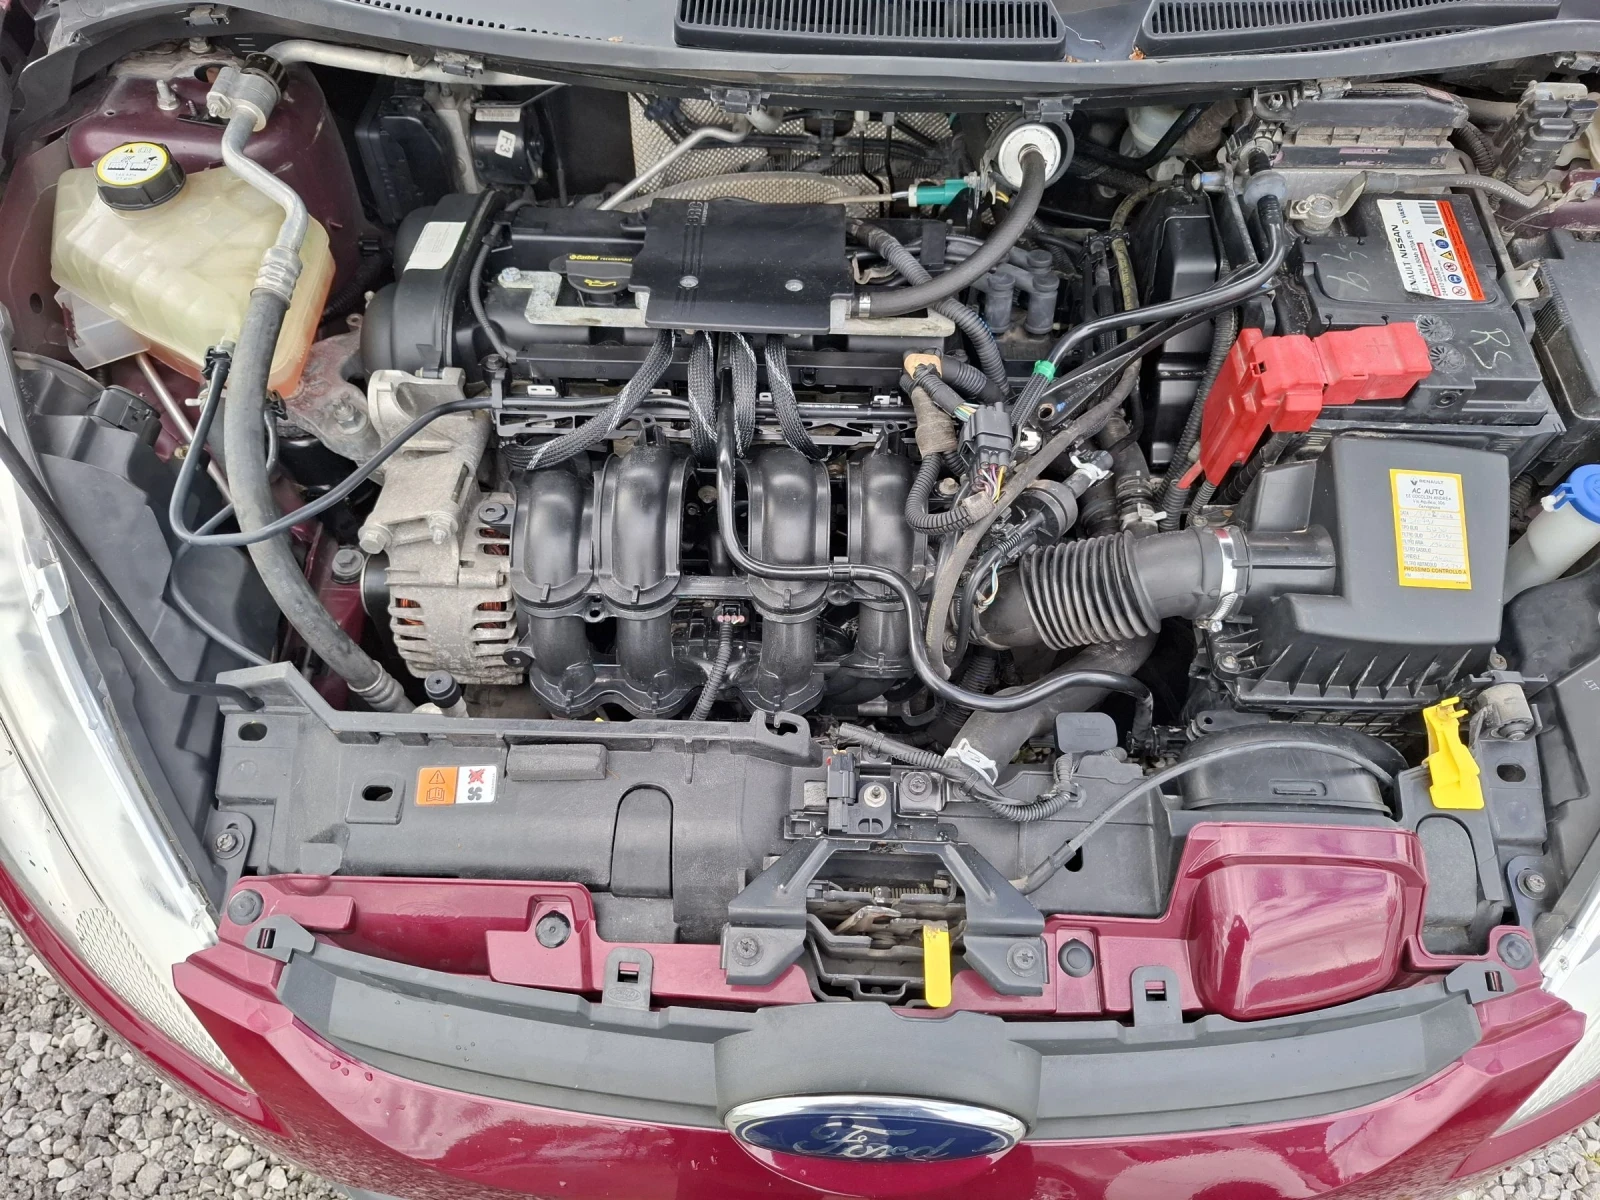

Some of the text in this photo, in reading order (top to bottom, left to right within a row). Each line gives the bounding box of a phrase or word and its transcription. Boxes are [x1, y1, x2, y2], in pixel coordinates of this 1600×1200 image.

[500, 135, 513, 153] F3
[1396, 202, 1406, 218] VARTA
[1391, 225, 1408, 258] NISSAN
[1423, 488, 1445, 496] AUTO
[793, 1120, 956, 1162] Ford
